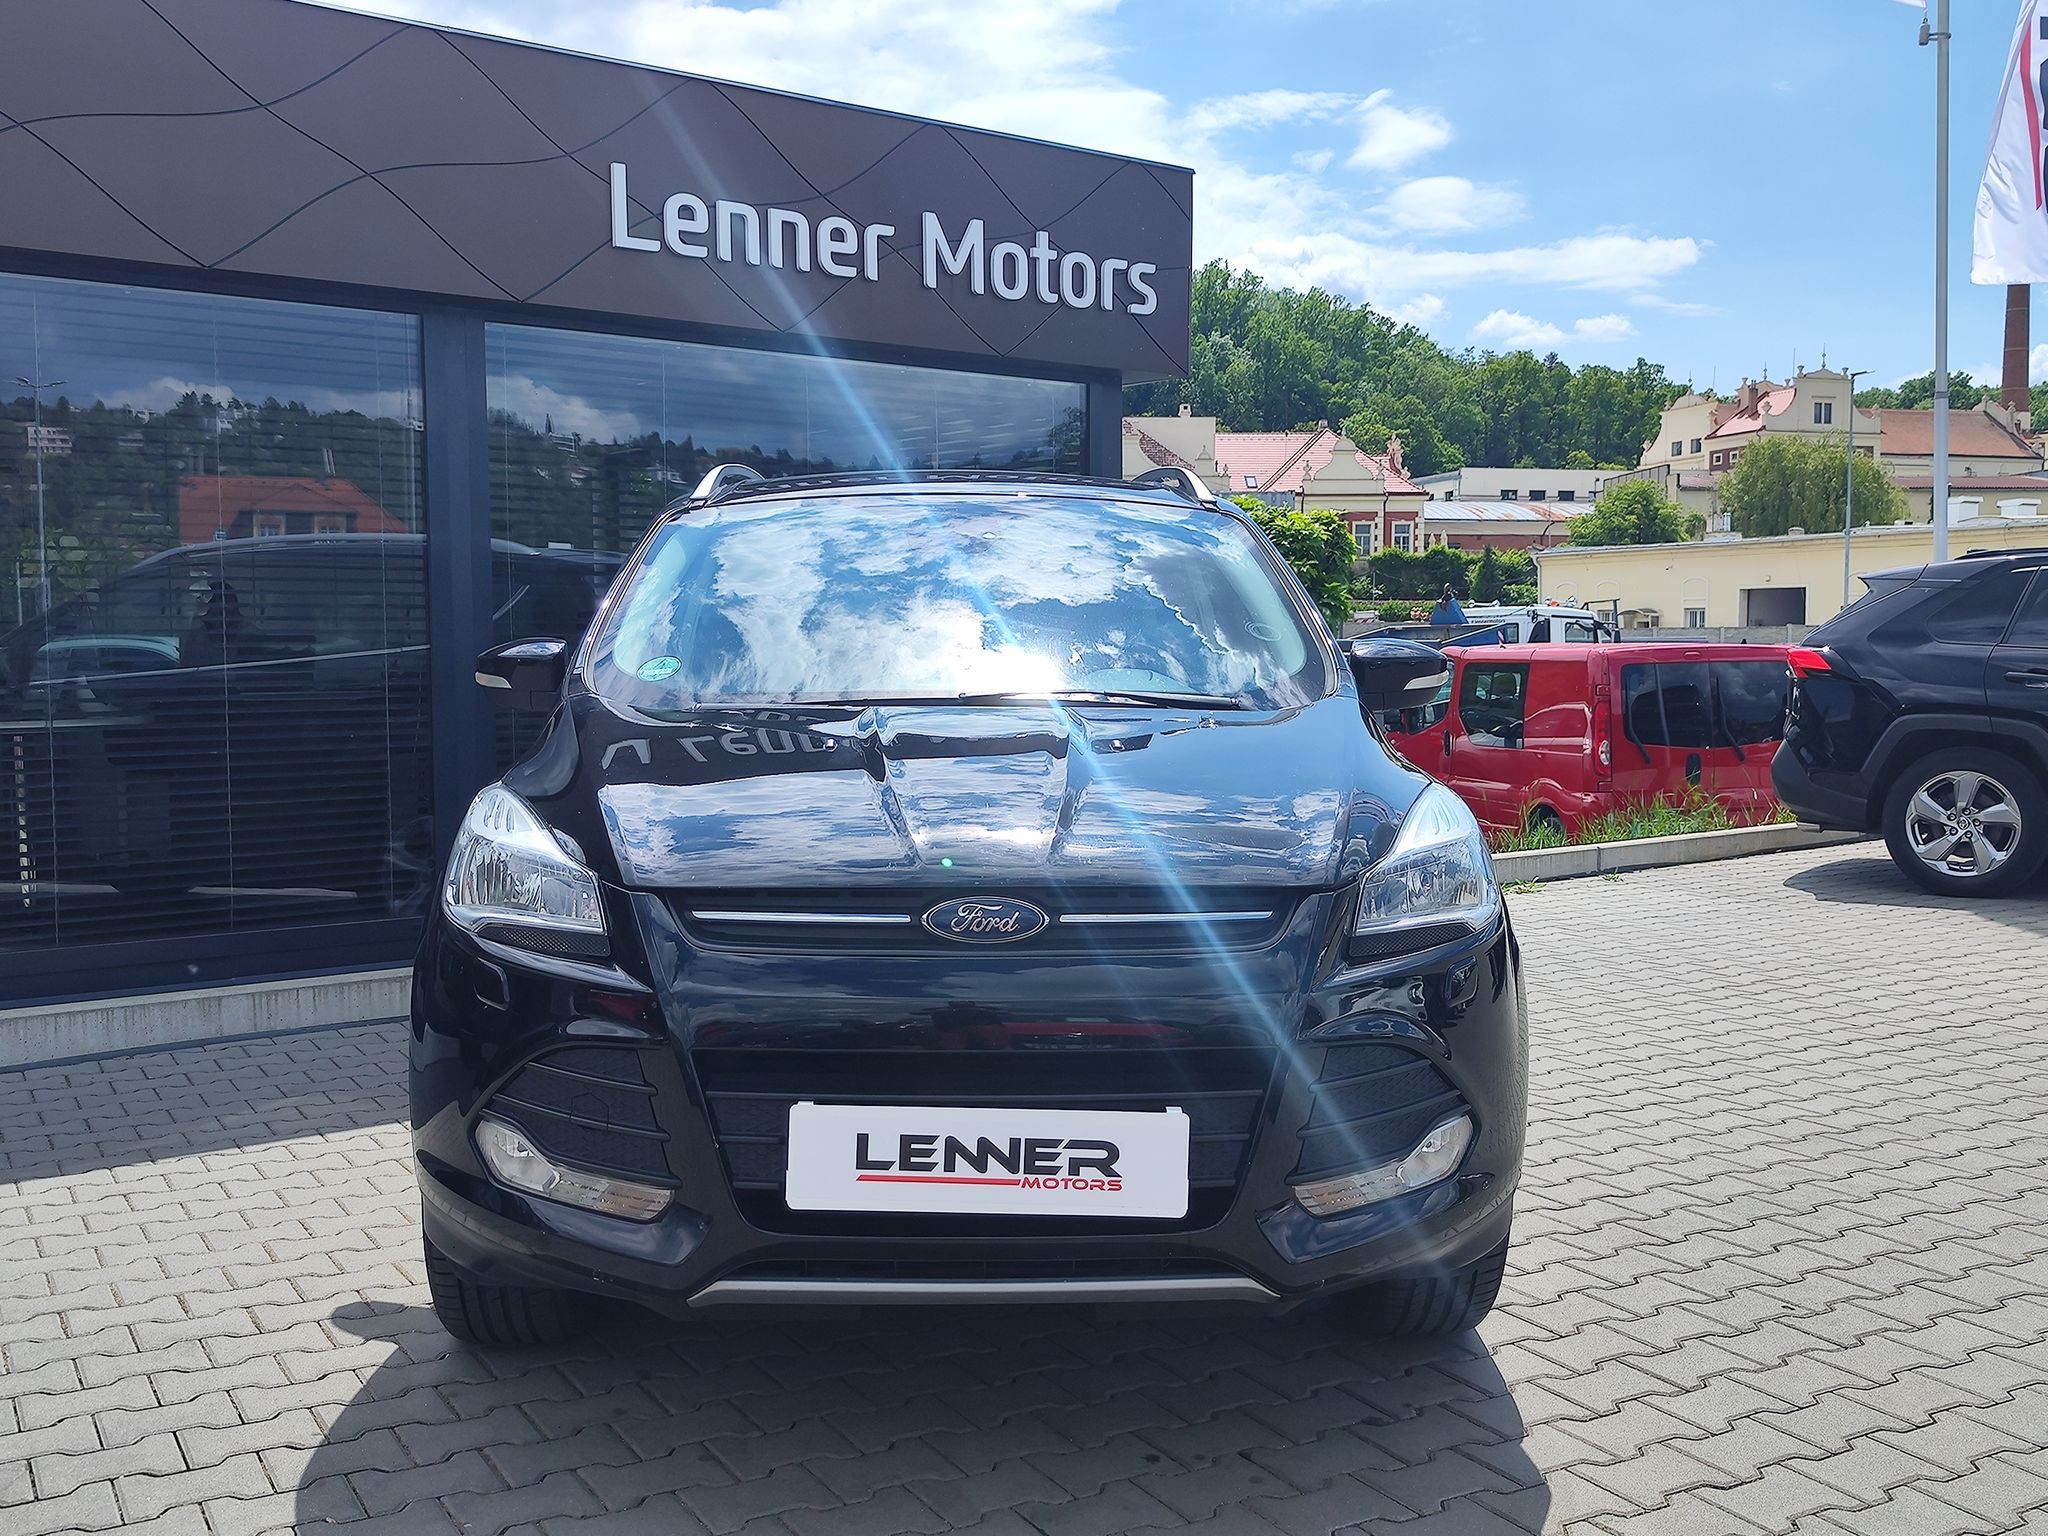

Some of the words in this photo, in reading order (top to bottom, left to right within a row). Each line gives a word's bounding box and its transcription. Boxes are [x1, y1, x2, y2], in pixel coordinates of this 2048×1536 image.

[610, 162, 896, 282] Lenner
[922, 211, 1158, 316] Motors
[950, 902, 1021, 933] Ford
[855, 1132, 1123, 1178] LENNER
[1021, 1176, 1123, 1192] MOTORS
